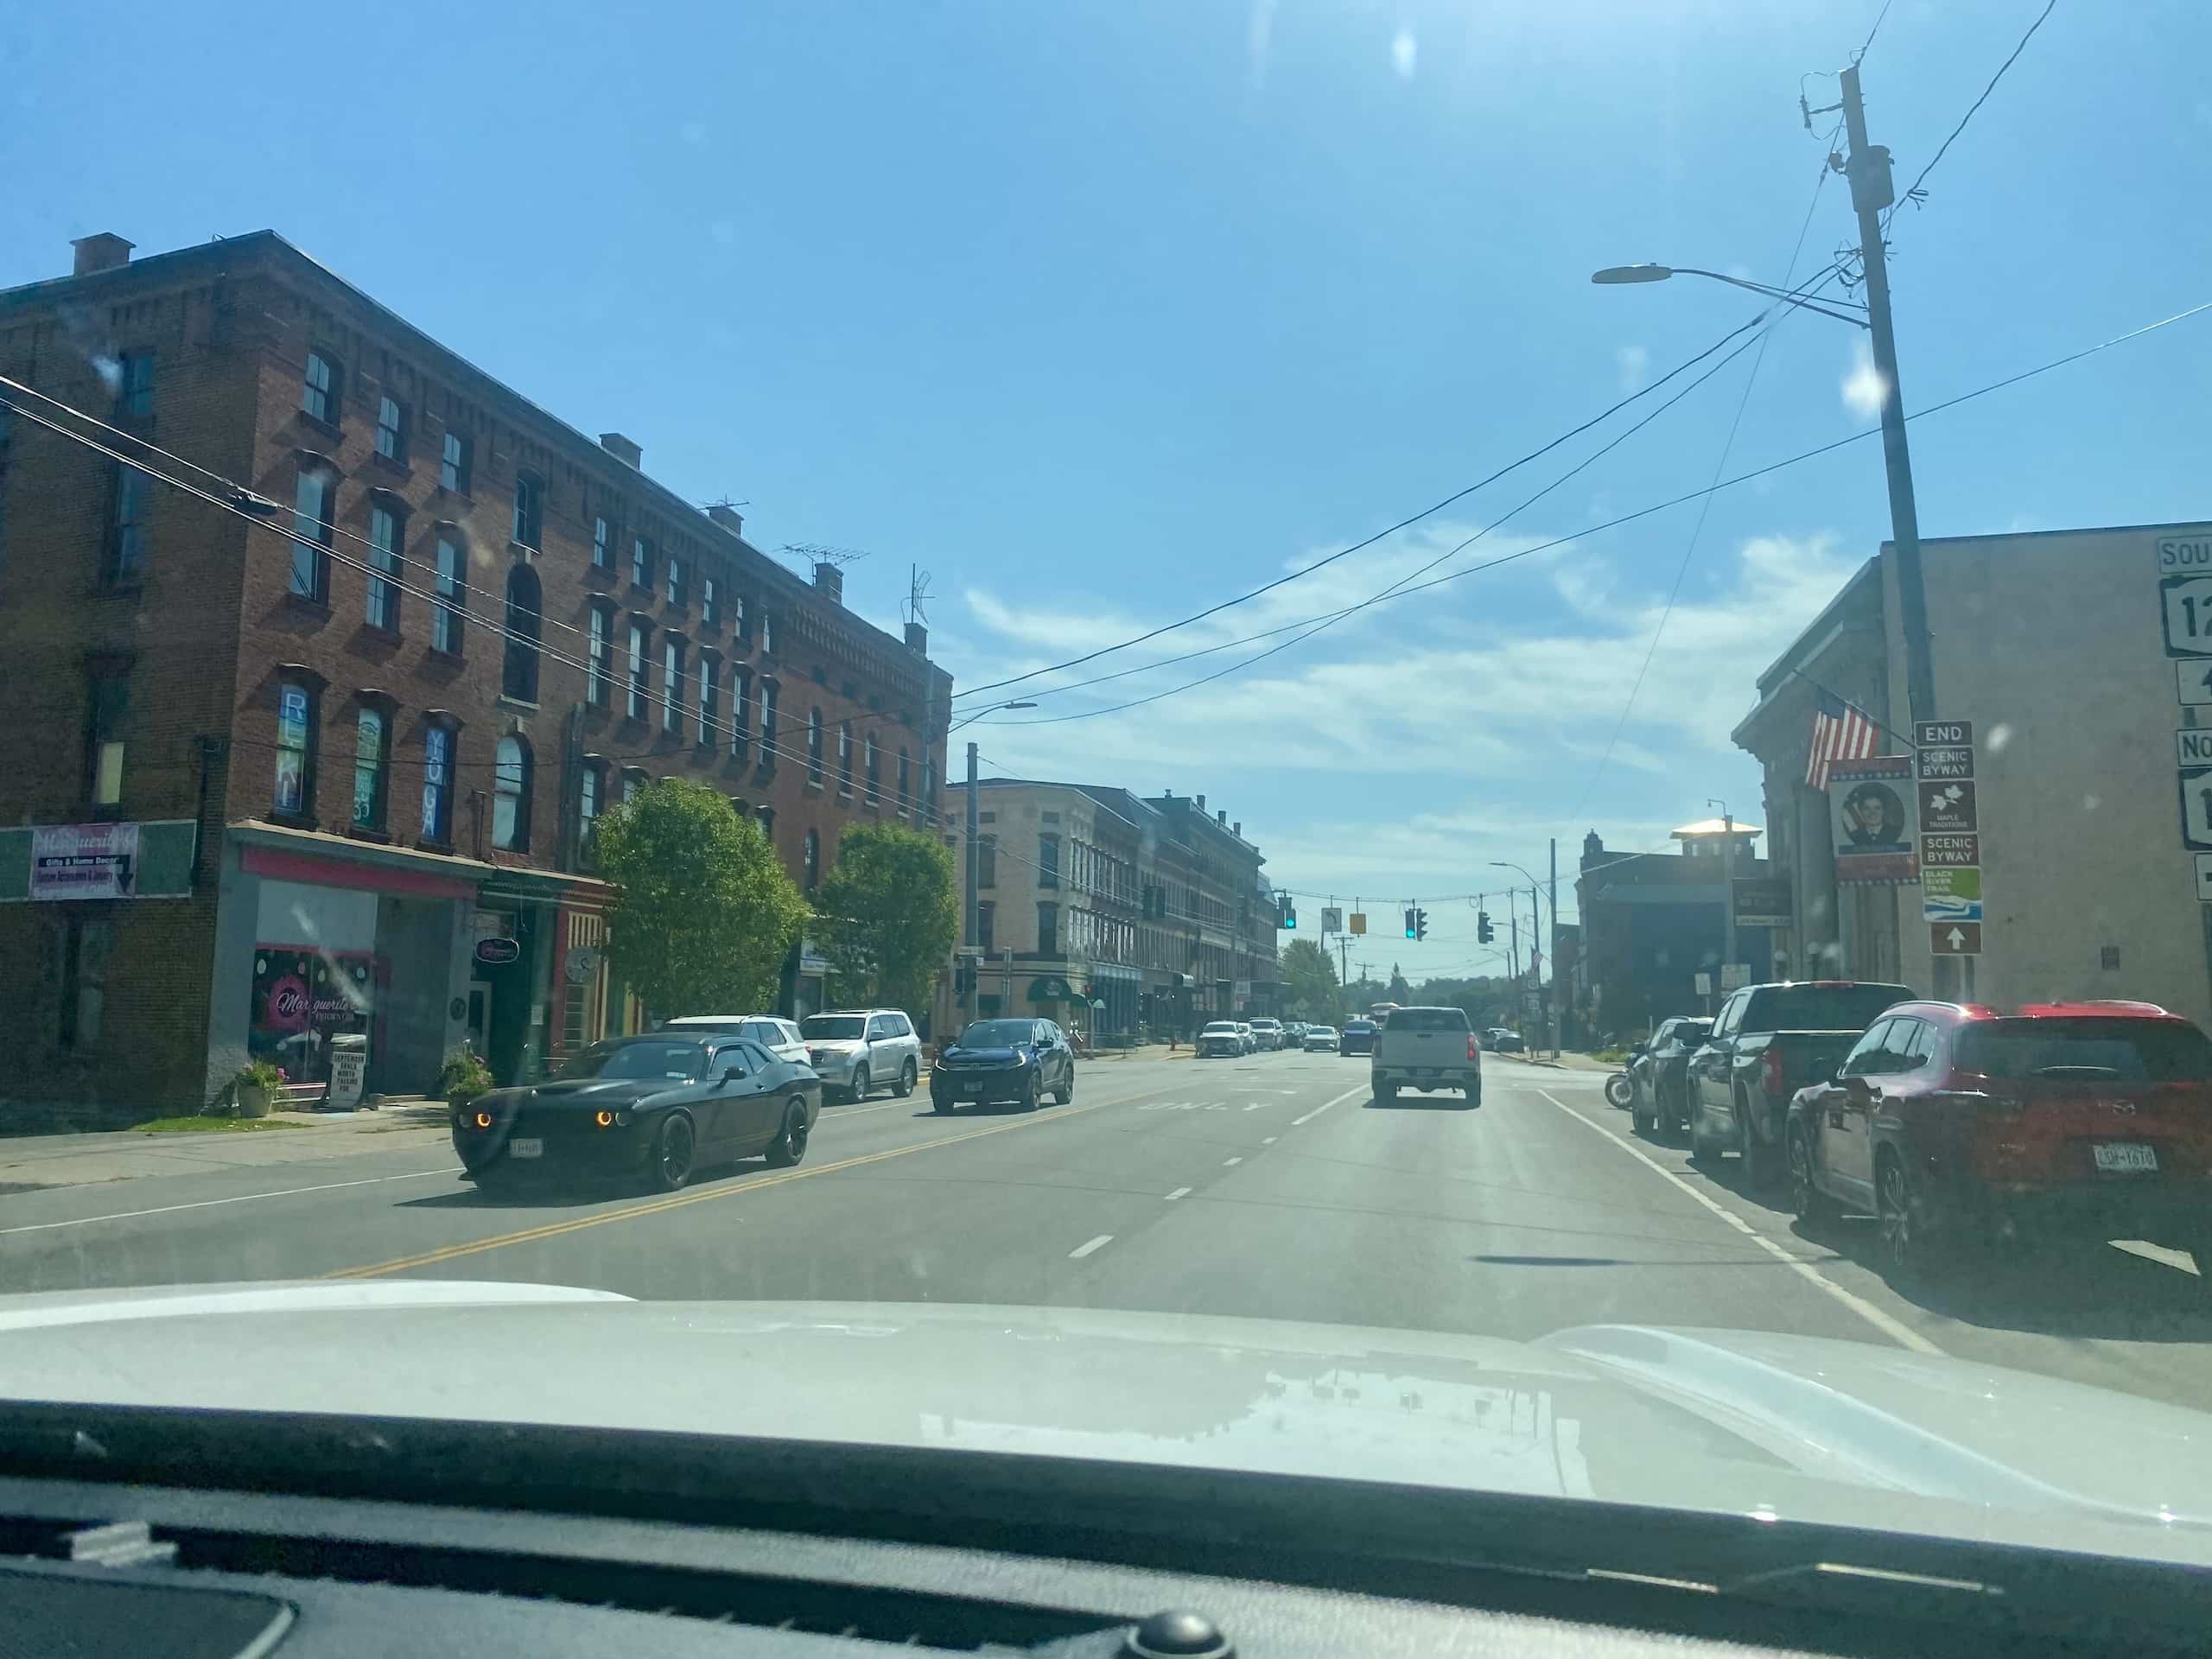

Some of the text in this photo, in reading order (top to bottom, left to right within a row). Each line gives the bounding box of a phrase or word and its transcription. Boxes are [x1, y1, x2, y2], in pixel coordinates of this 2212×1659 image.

[1925, 726, 1962, 741] END
[1923, 751, 1967, 763] SCENIC
[1923, 765, 1967, 776] BYWAY
[423, 730, 445, 836] YOGA
[1927, 838, 1972, 849] SCENIC
[1927, 851, 1972, 862] BYWAY
